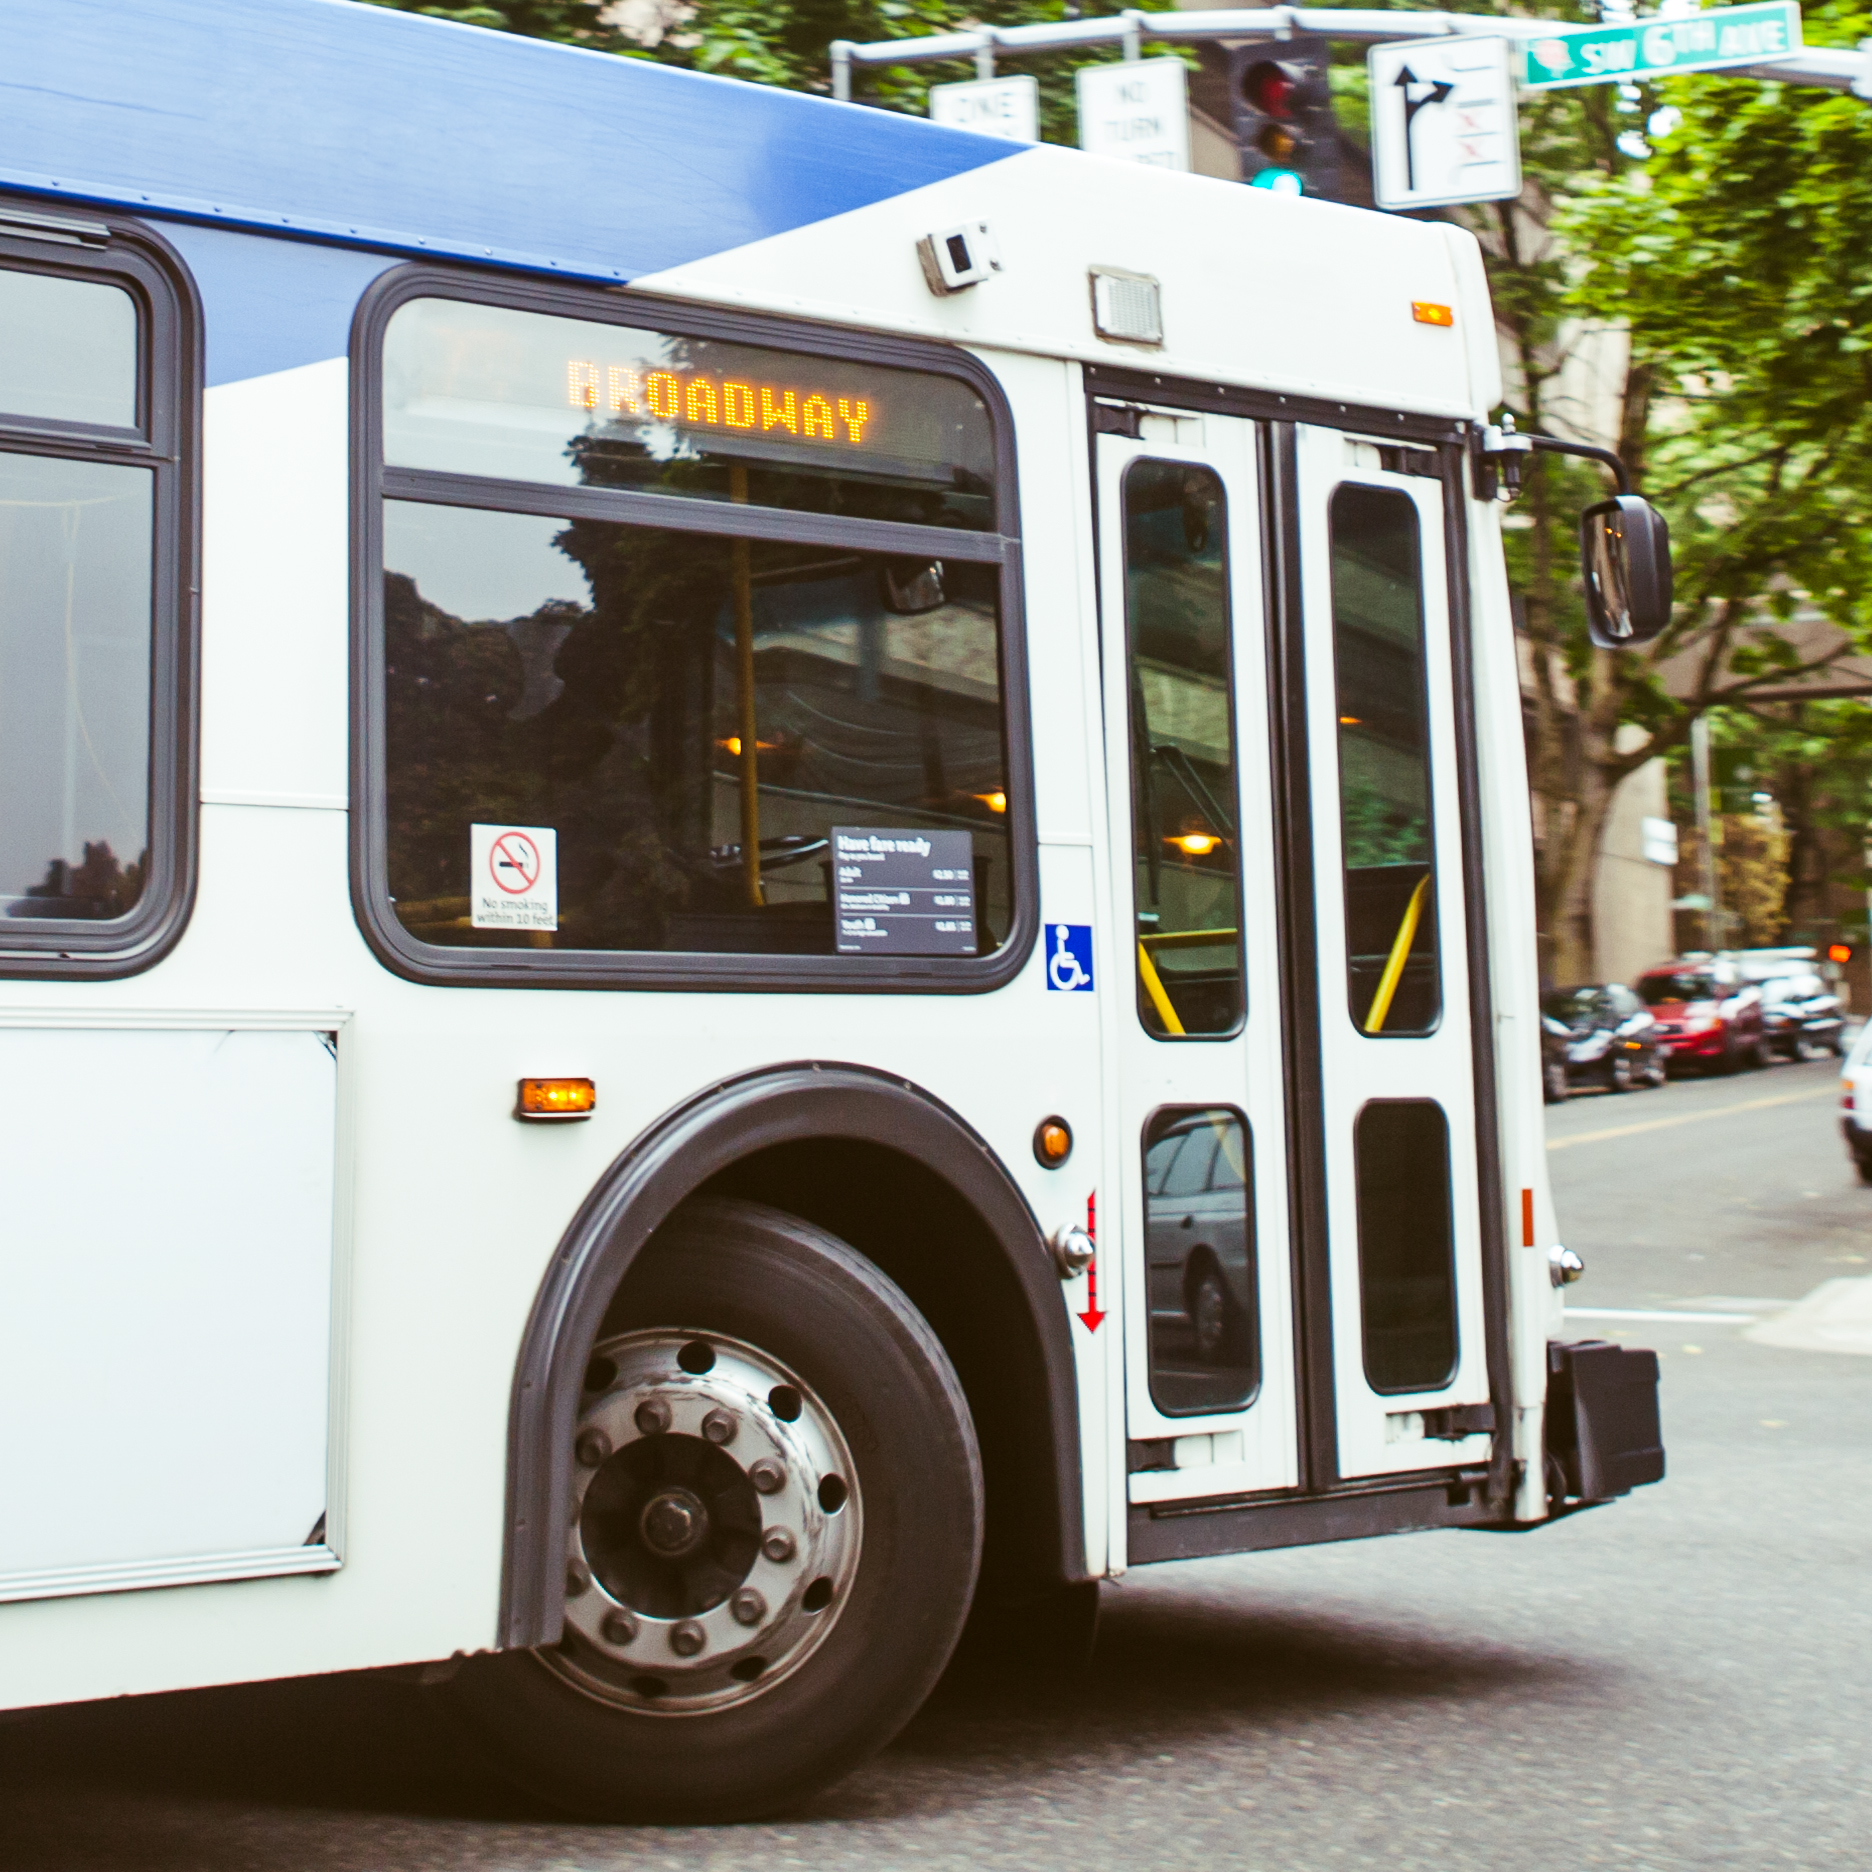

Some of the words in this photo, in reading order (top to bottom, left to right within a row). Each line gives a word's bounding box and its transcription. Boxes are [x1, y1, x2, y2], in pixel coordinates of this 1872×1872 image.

[1580, 39, 1637, 74] SW
[1643, 20, 1716, 66] 6TH
[1718, 20, 1787, 57] AVE
[567, 360, 869, 444] BROADWAY
[837, 835, 870, 851] Have
[868, 835, 896, 852] fare
[895, 837, 931, 857] ready
[481, 897, 497, 908] No
[500, 898, 548, 915] smoking
[476, 910, 513, 924] within
[516, 913, 530, 925] 10
